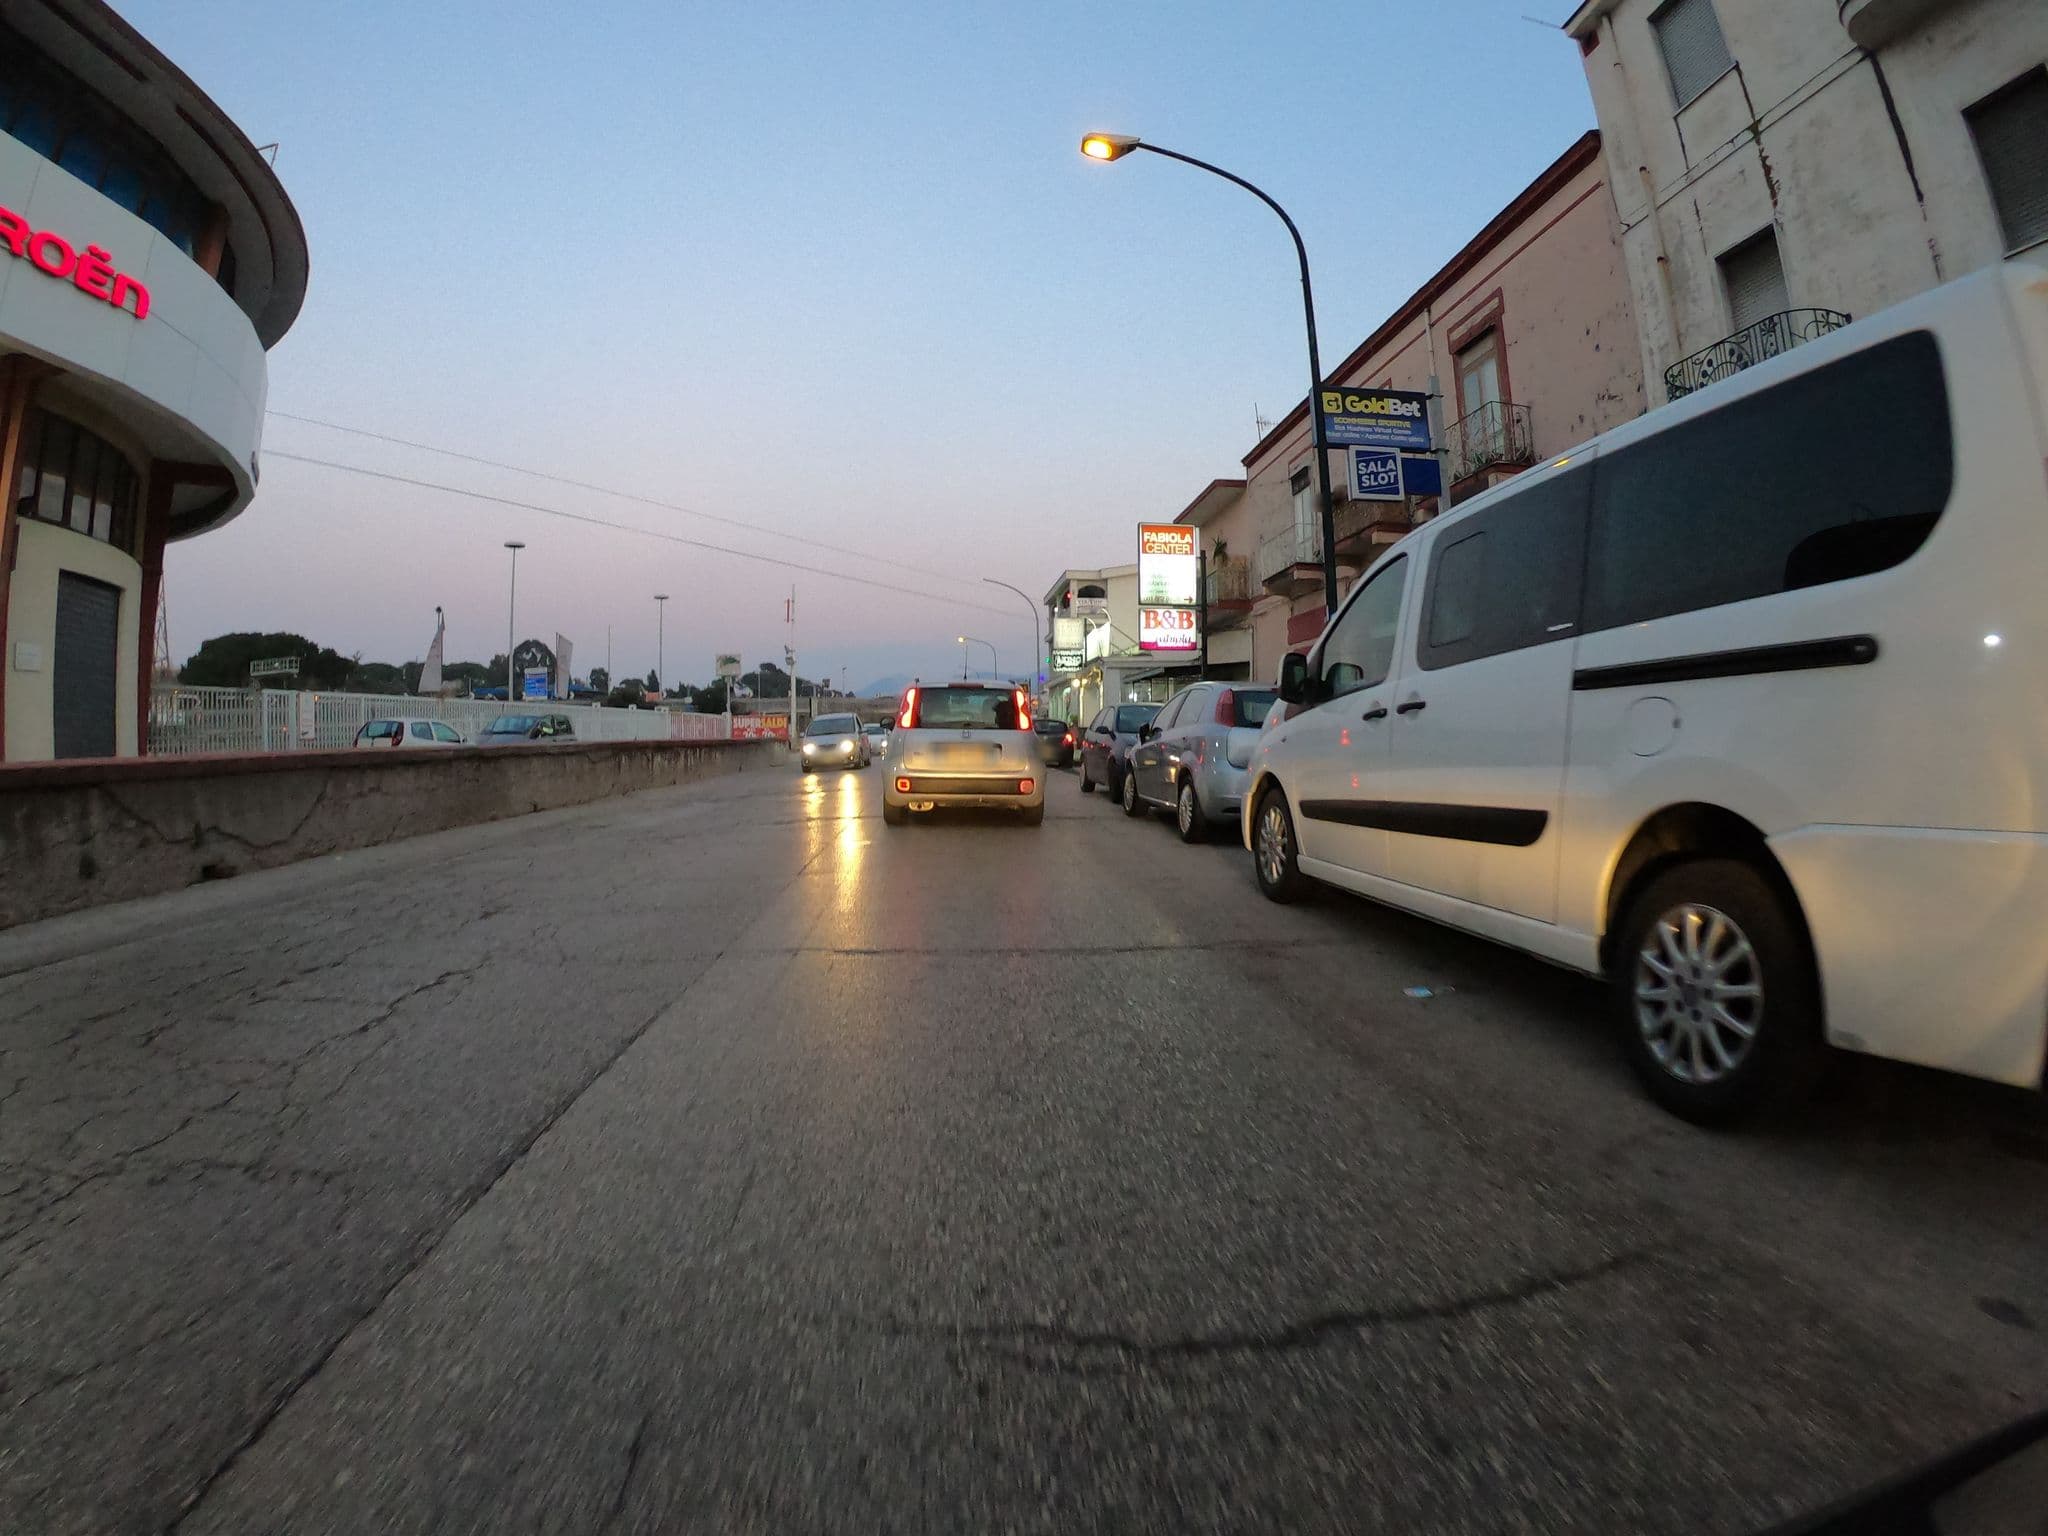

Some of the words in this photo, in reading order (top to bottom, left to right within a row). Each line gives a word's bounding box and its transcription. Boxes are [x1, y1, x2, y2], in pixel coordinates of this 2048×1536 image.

[1345, 395, 1421, 418] GoldBet
[1358, 459, 1396, 475] SALA
[1361, 471, 1397, 487] SLOT
[1143, 531, 1193, 544] FABIOLA
[1145, 542, 1190, 554] CENTER
[1143, 609, 1194, 630] B&B
